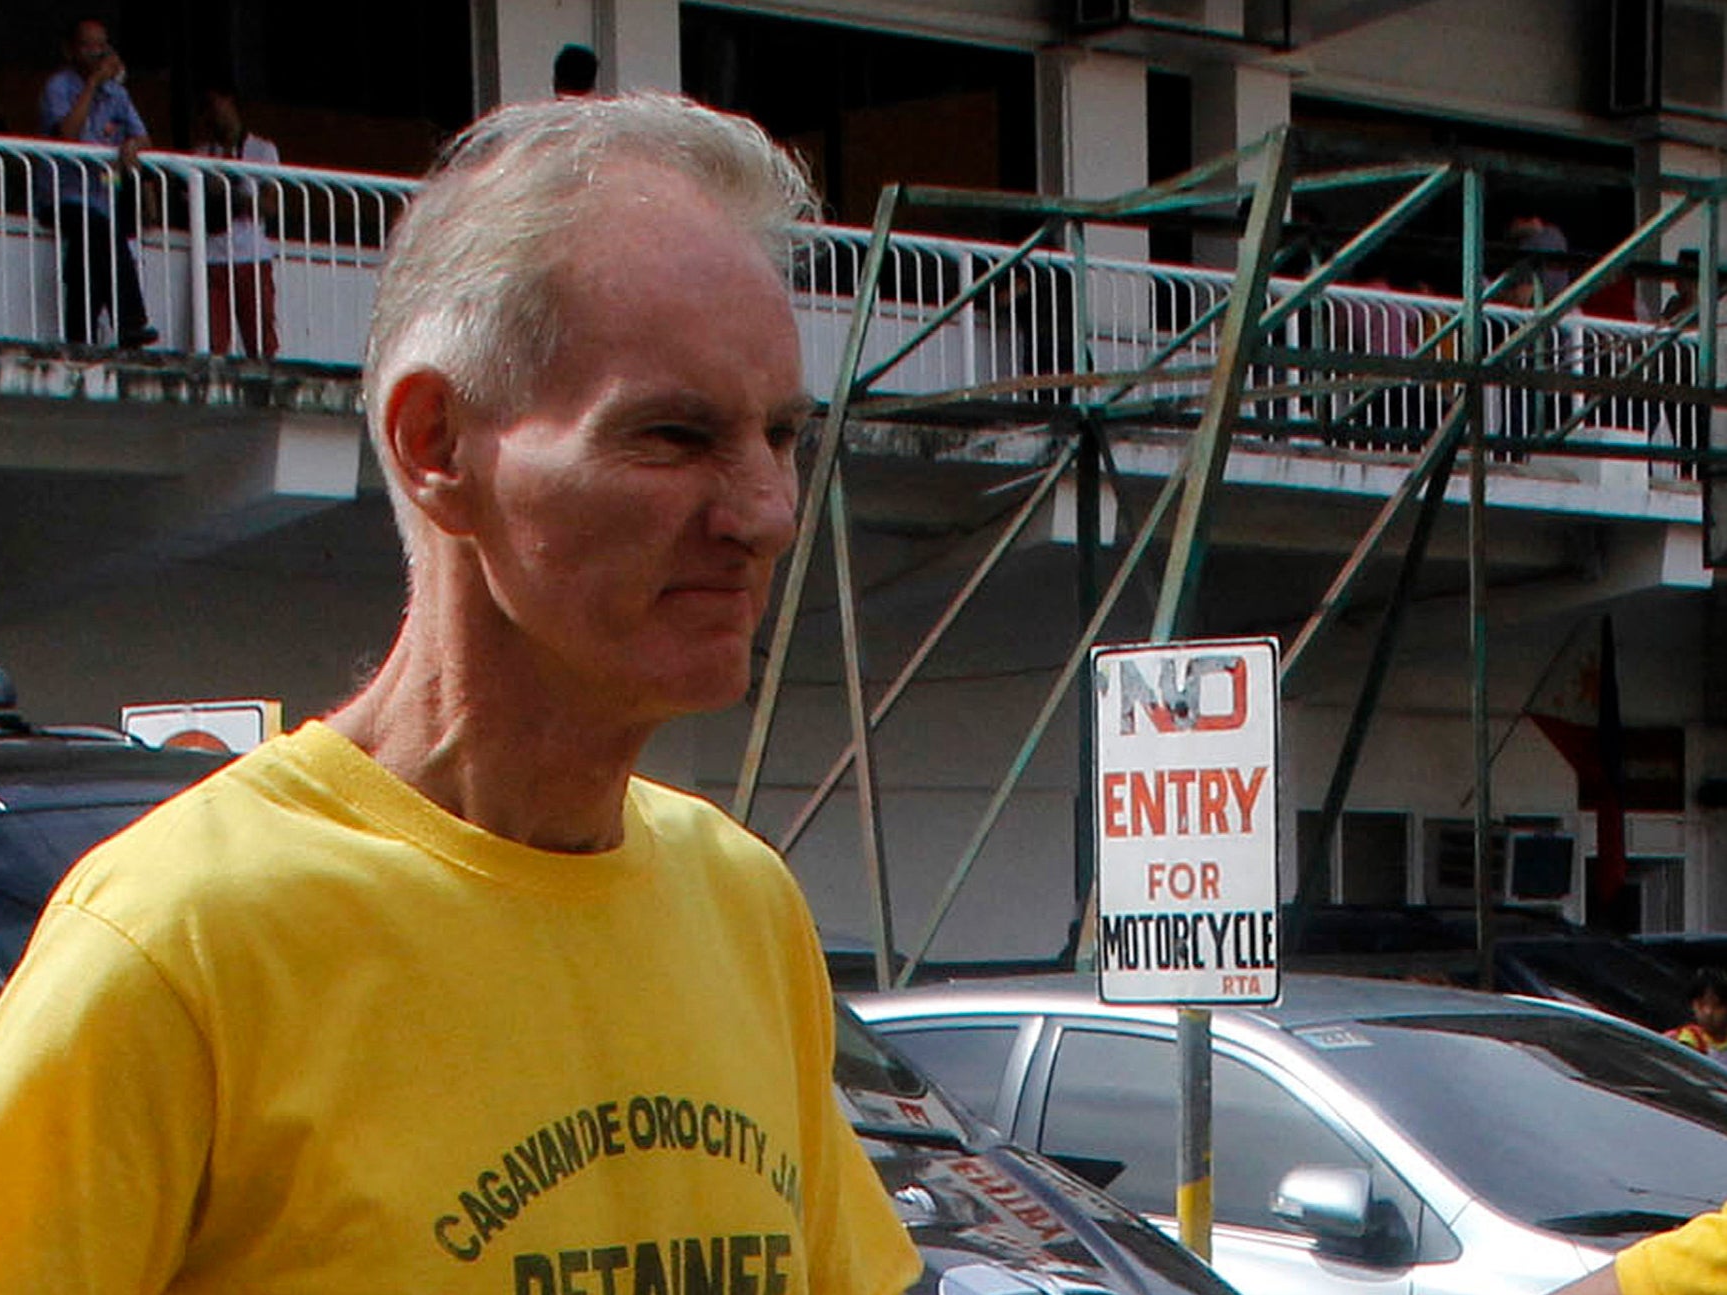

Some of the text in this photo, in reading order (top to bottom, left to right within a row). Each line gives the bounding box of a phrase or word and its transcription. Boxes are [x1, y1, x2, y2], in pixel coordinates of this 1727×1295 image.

[1119, 656, 1248, 736] NO
[1102, 766, 1269, 838] ENTRY
[1147, 861, 1221, 901] FOR
[1102, 911, 1274, 971] MOTORCYCLE
[1221, 974, 1262, 996] RTA
